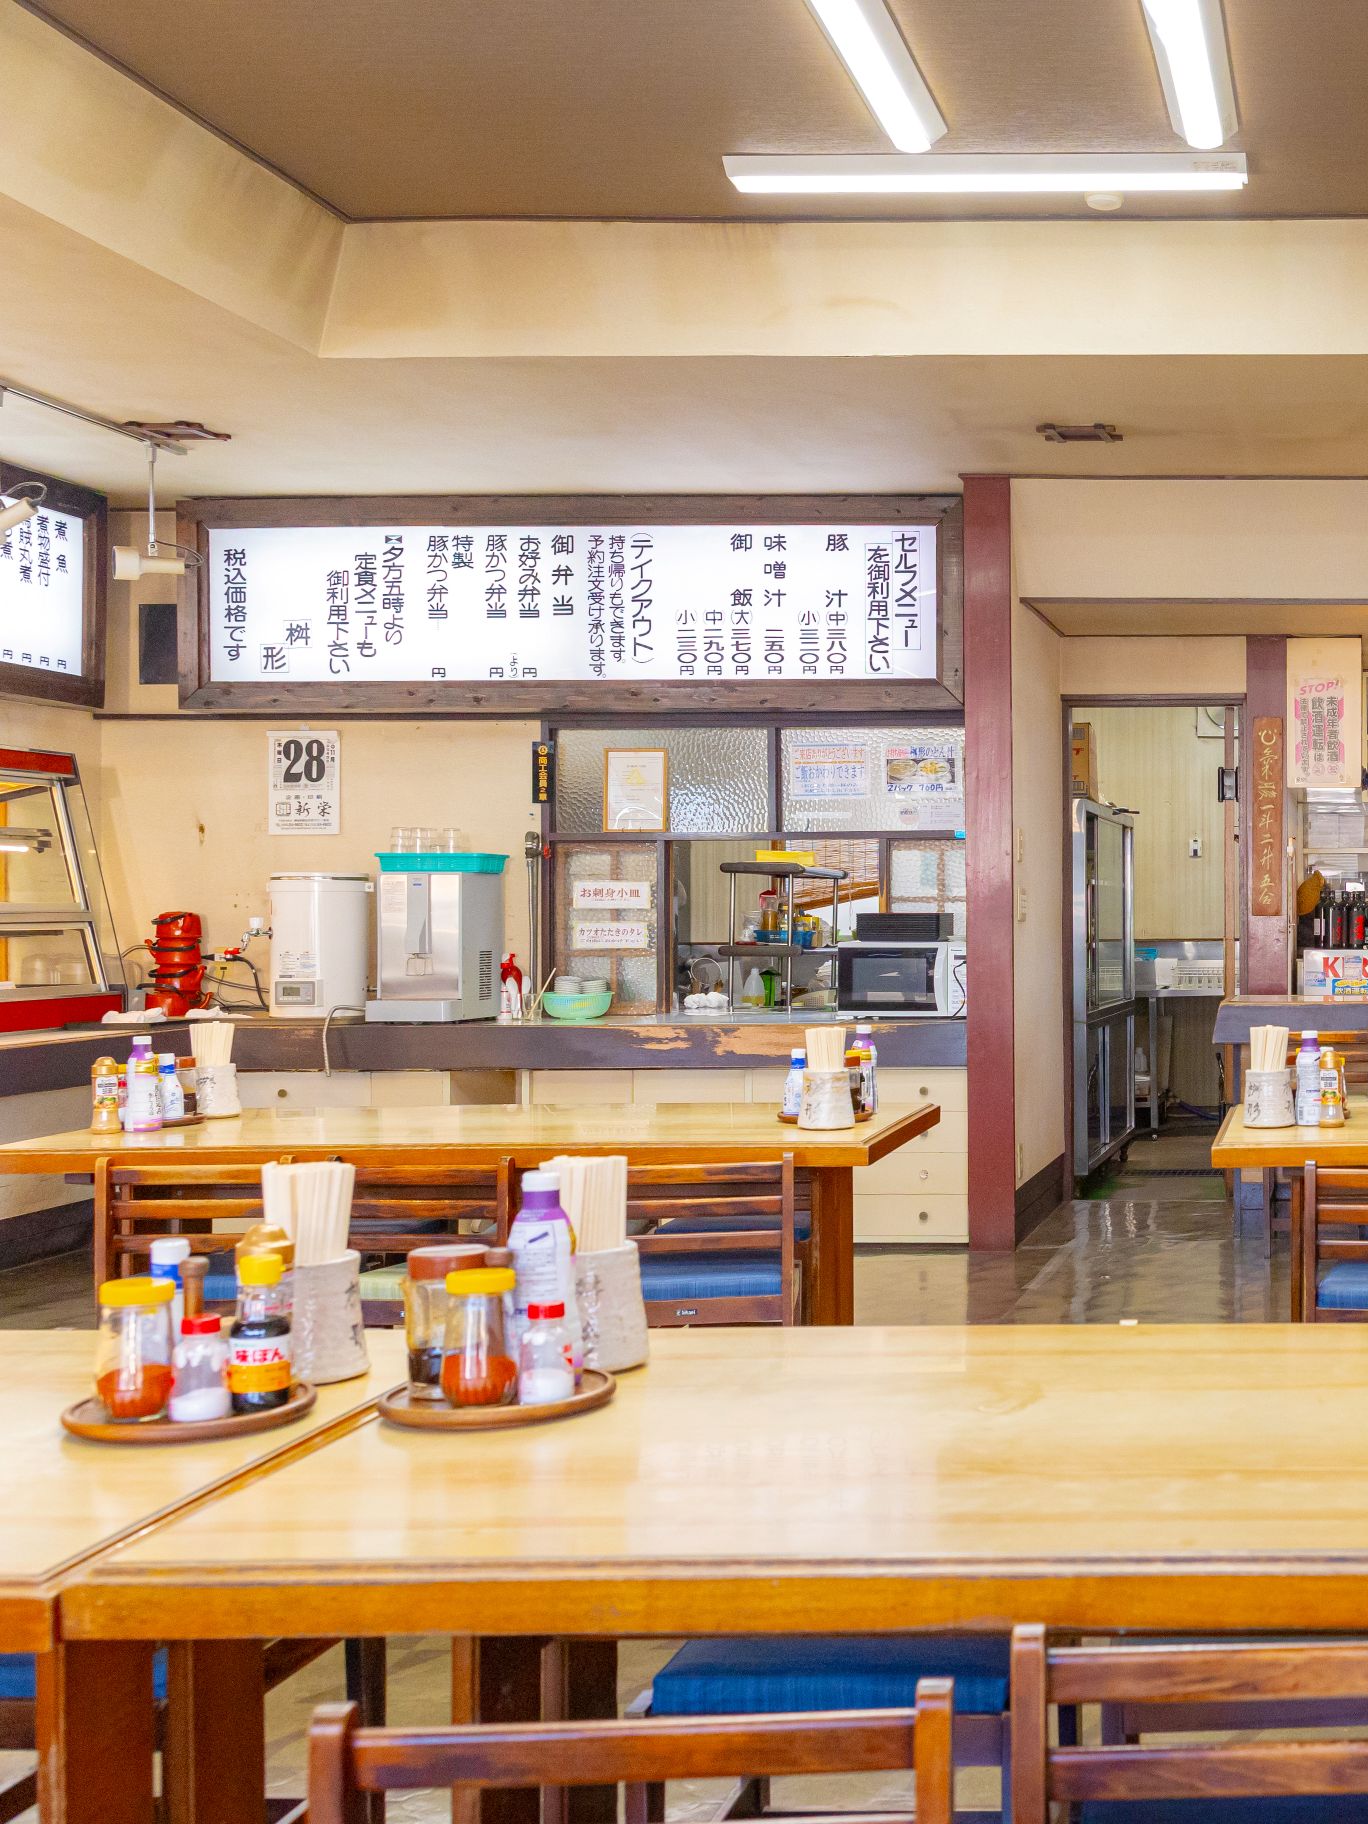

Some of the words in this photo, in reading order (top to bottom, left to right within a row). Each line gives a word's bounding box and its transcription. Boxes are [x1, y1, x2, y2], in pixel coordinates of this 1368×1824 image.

[55, 520, 68, 574] 煮魚
[427, 536, 449, 619] 豚かつ弁当
[452, 535, 474, 568] 特製
[485, 535, 507, 618] 豚かつ弁当
[518, 535, 541, 618] お好み弁当
[551, 535, 574, 615] 御弁当
[731, 534, 752, 606] 御飯
[764, 534, 786, 607] 味噌汁
[826, 534, 849, 607] 豚汁
[224, 549, 247, 661] 税込価格です
[327, 571, 349, 674] 御利用下さい
[354, 552, 377, 657] 定食メニューも
[382, 546, 404, 645] 夕方五時より
[586, 535, 608, 679] 予約注文受け承ります。
[609, 535, 625, 662] 持ち帰りもできます。
[867, 546, 890, 672] を御利用下さい
[894, 531, 919, 647] セルフメニュー
[3, 650, 12, 659] 円
[22, 653, 32, 663] 円
[40, 656, 50, 666] 円
[57, 660, 67, 669] 円
[263, 647, 286, 669] 形
[432, 668, 445, 677] 円
[490, 668, 503, 677] 円
[523, 668, 537, 677] 円
[1299, 680, 1339, 695] STOP!
[283, 739, 325, 782] 28
[1312, 697, 1324, 762] 飲酒運転は
[1327, 697, 1339, 761] 未成年者飲酒
[580, 888, 640, 898] お刺身小皿
